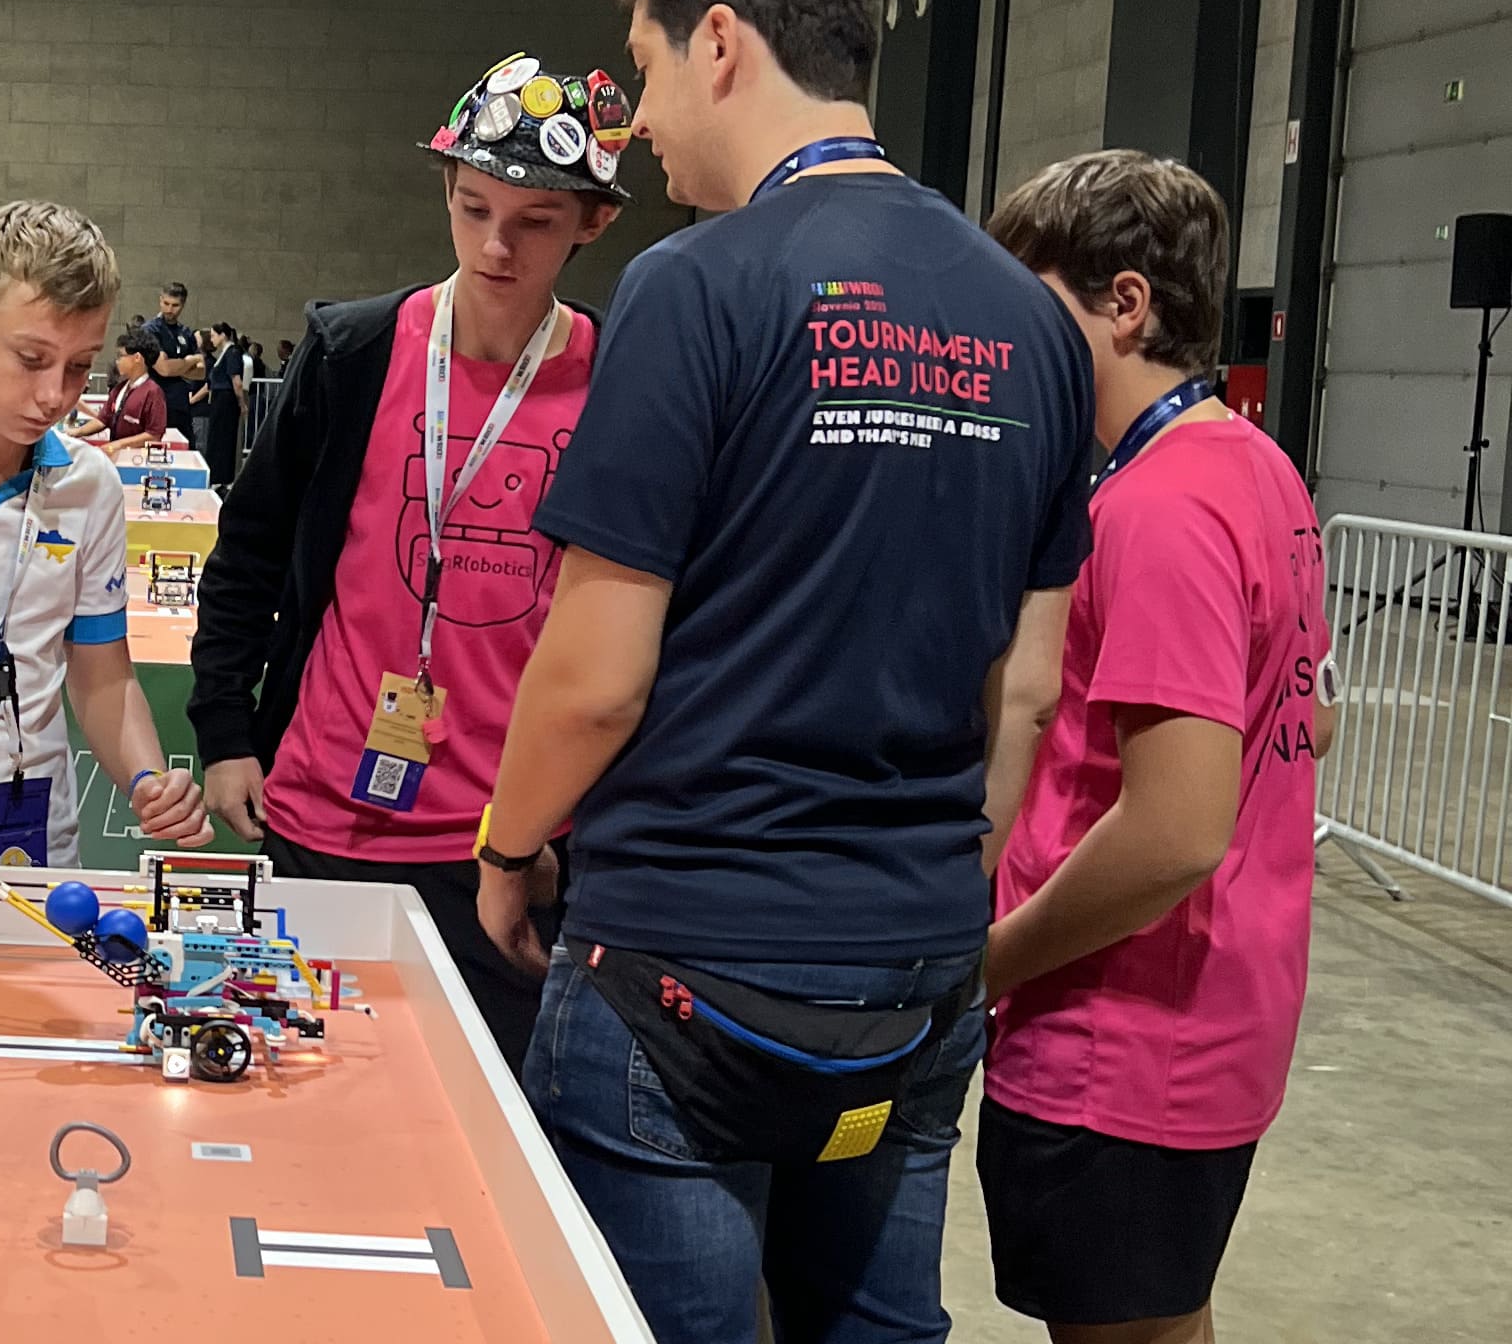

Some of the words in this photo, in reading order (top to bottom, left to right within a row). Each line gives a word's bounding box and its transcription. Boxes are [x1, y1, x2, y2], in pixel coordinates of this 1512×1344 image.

[807, 319, 1014, 371] TOURNAMENT
[810, 356, 901, 390] HEAD
[909, 360, 992, 404] JUDGE
[809, 429, 855, 444] AND
[812, 410, 861, 425] EVEN
[864, 409, 915, 427] JUDGES
[943, 419, 956, 435] A
[960, 421, 1001, 442] BOSS
